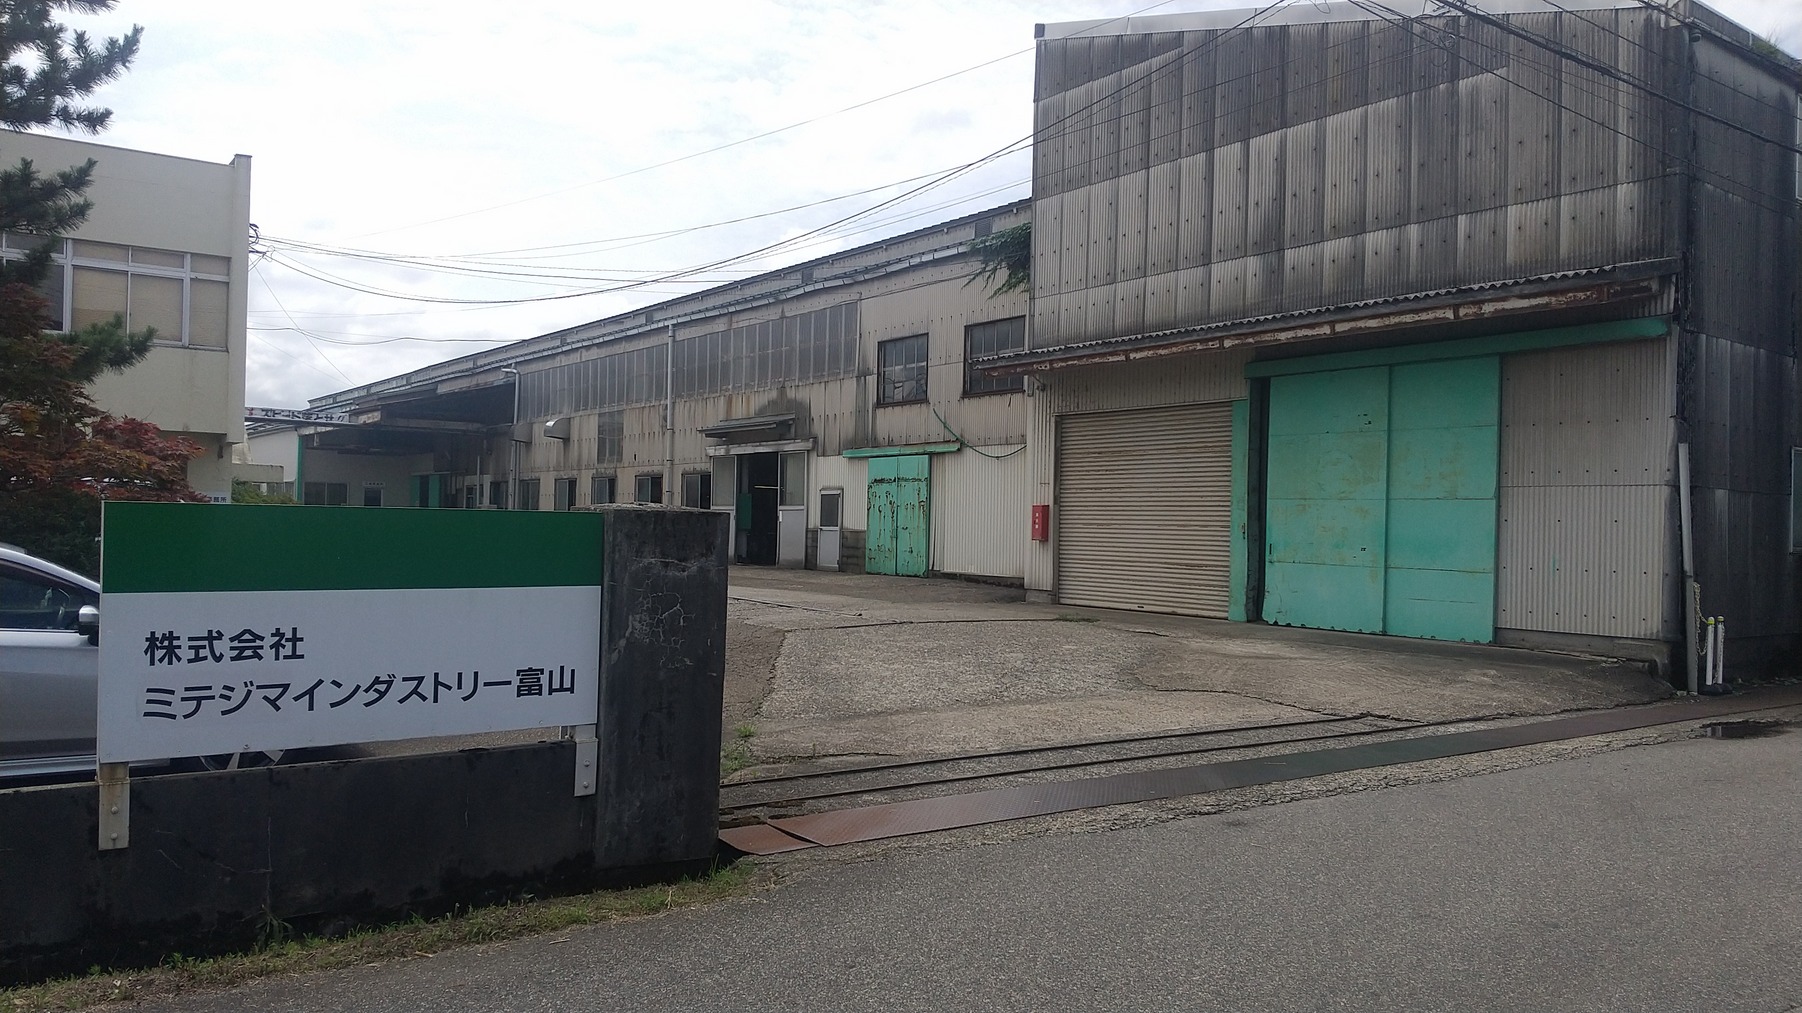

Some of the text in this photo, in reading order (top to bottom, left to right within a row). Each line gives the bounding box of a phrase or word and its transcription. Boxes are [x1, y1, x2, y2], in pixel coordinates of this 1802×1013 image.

[143, 627, 305, 666] 株式会社
[143, 665, 577, 721] ミテジマインダストリー富山
